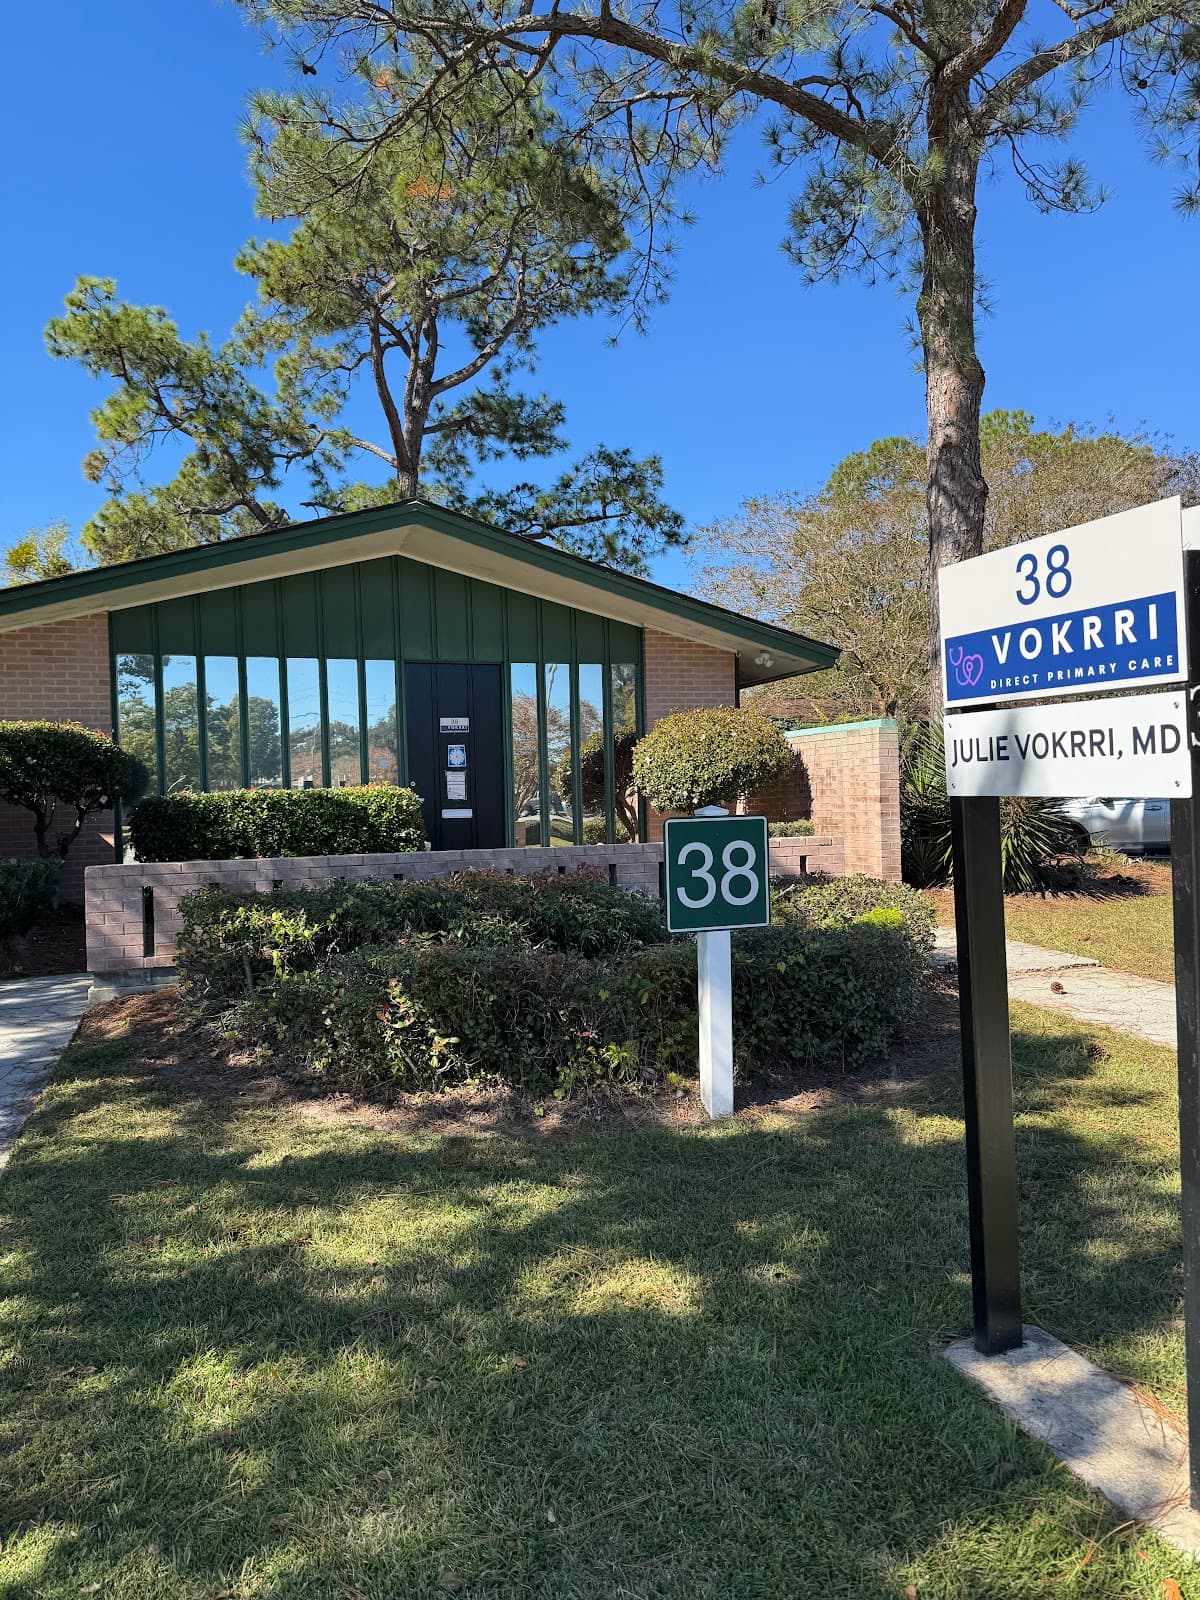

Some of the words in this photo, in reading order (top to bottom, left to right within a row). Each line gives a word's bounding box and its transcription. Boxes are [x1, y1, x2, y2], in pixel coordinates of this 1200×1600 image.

[1016, 544, 1072, 606] 38
[991, 603, 1158, 664] VOKRRI
[990, 673, 1039, 689] DIRECT
[1047, 662, 1117, 681] PRIMARY
[1128, 654, 1174, 671] CARE
[951, 735, 1010, 768] JULIE
[1014, 728, 1123, 761] VOKRRI,
[1132, 724, 1181, 756] MD
[677, 840, 759, 909] 38
